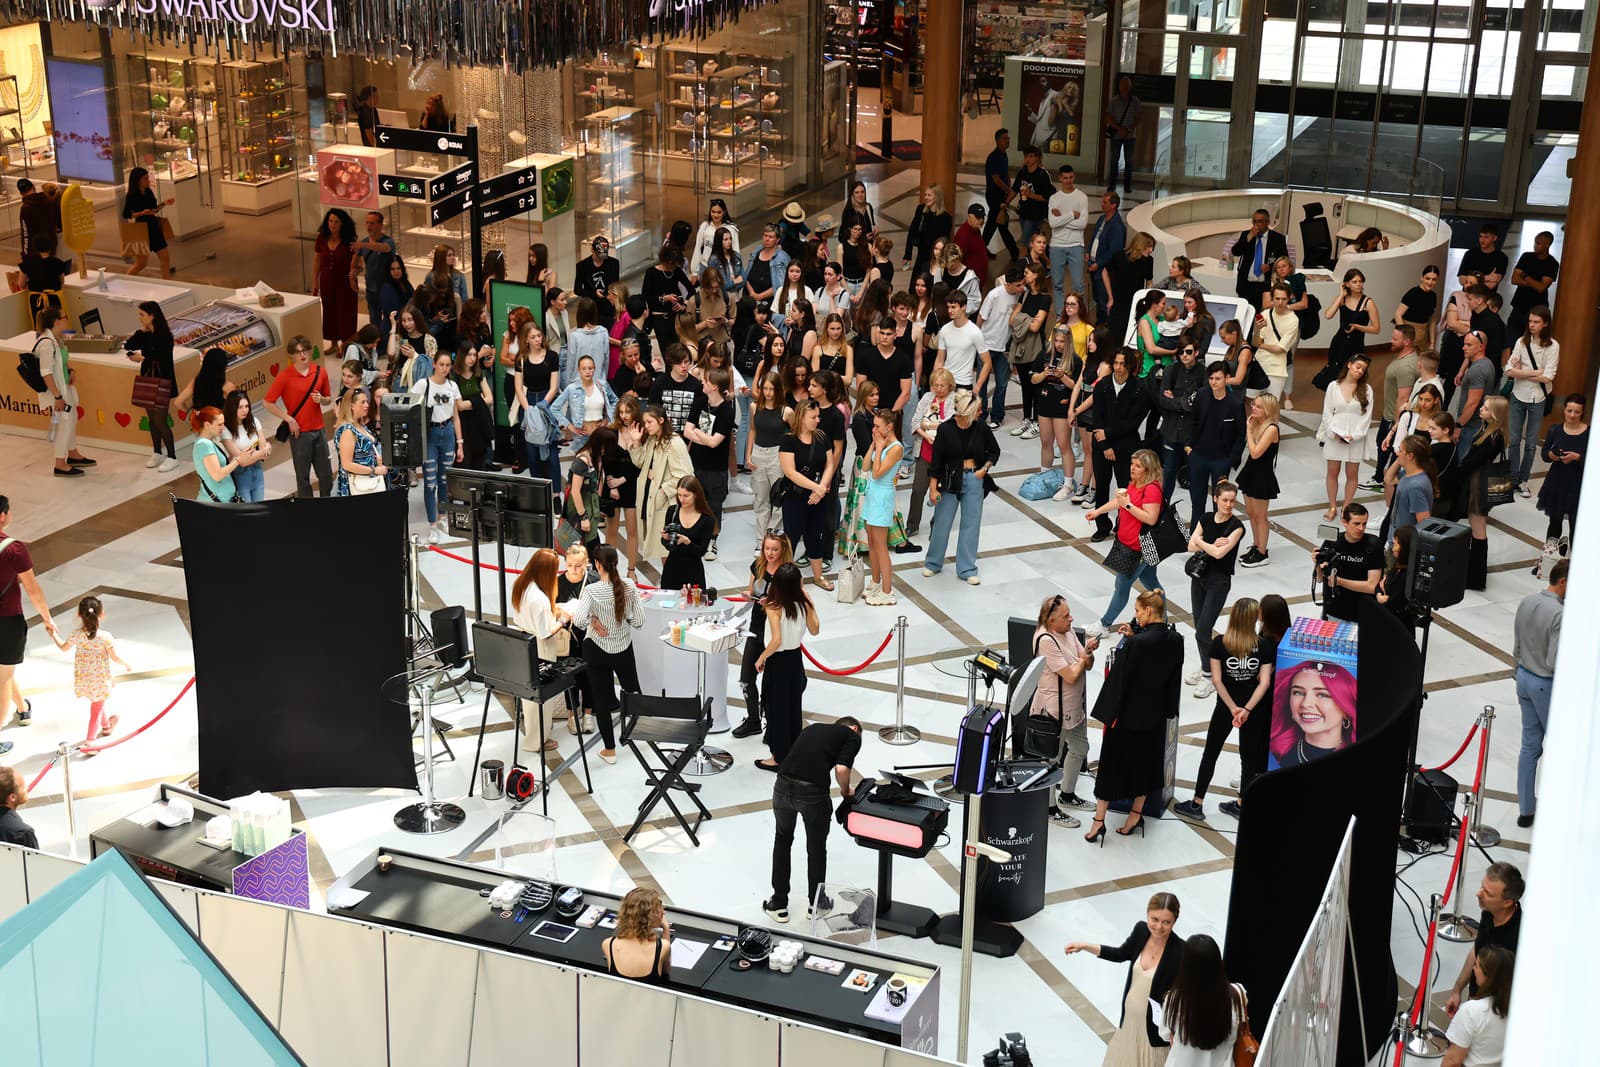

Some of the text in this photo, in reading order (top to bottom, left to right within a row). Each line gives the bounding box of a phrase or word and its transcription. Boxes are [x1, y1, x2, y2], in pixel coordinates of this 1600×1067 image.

[848, 0, 875, 8] CANEL
[137, 0, 337, 31] SWAROVSKI
[1023, 64, 1084, 75] paco rabanne
[237, 370, 266, 392] rinela
[0, 394, 53, 417] Marinel
[1302, 667, 1337, 679] Schwarzkopf
[987, 832, 1035, 846] Schwarzkopf
[1000, 863, 1022, 871] YOUR
